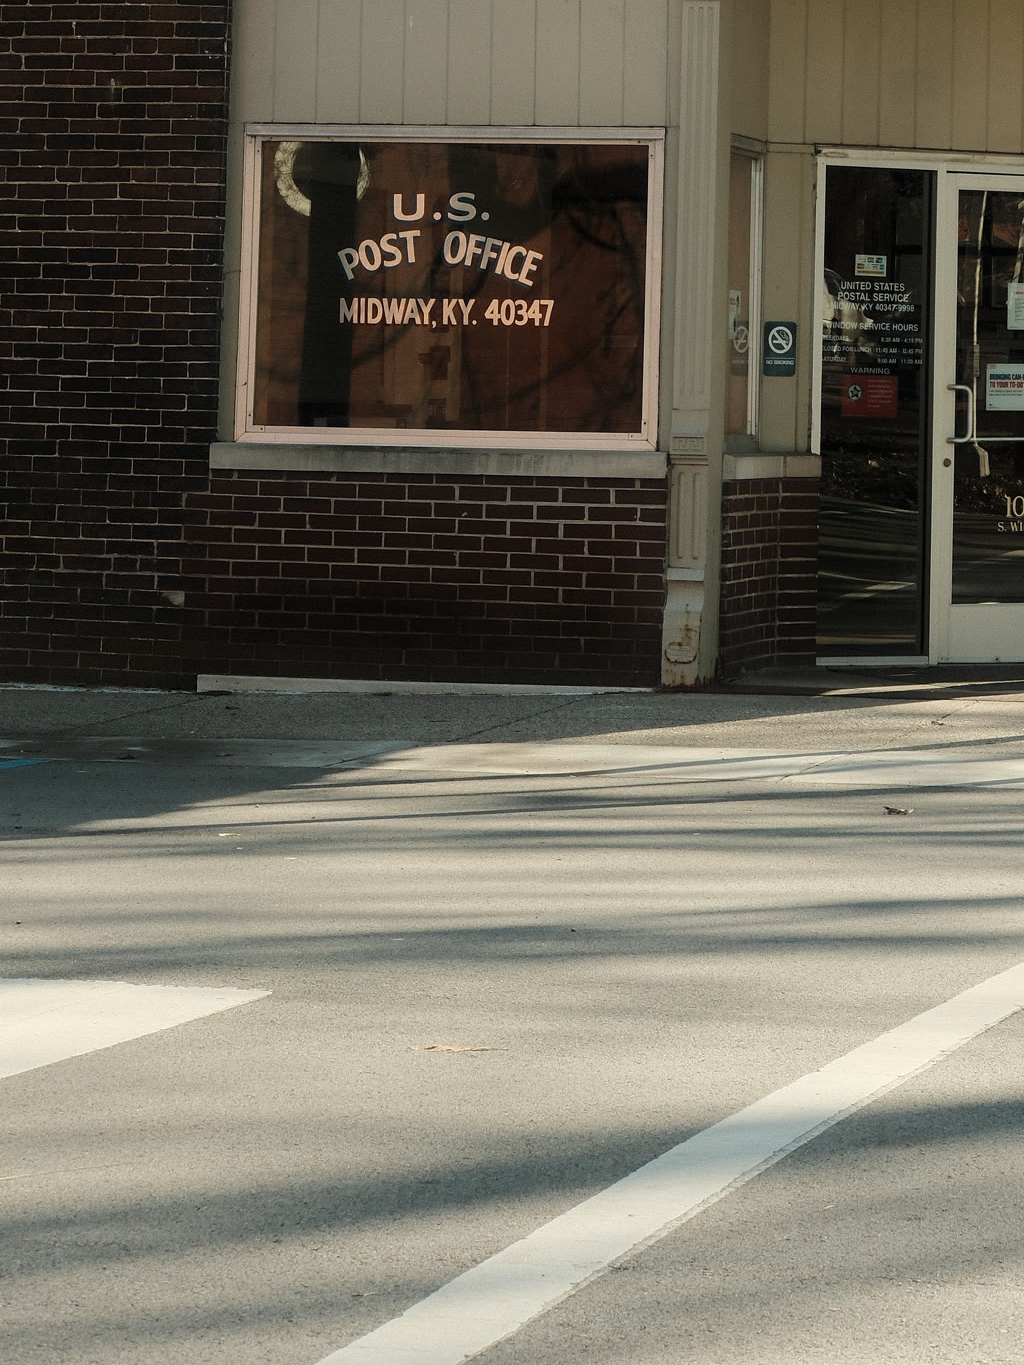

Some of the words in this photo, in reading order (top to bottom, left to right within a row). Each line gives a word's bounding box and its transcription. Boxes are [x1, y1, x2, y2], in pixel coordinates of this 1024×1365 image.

[393, 192, 490, 221] U.S.
[337, 229, 421, 281] POST
[443, 231, 544, 286] OFFICE
[840, 281, 872, 290] UNITED
[874, 282, 905, 292] STATES
[837, 292, 871, 301] POSTAL
[873, 293, 909, 303] SERVICE
[339, 297, 437, 328] MIDWAY,
[442, 298, 477, 326] KY.
[484, 299, 555, 327] 40347
[863, 303, 873, 311] KY
[875, 303, 915, 312] 40347-9998
[859, 322, 891, 331] SERVICE
[892, 324, 919, 332] HOURS
[850, 367, 890, 375] WARNING
[997, 522, 1007, 532] S.
